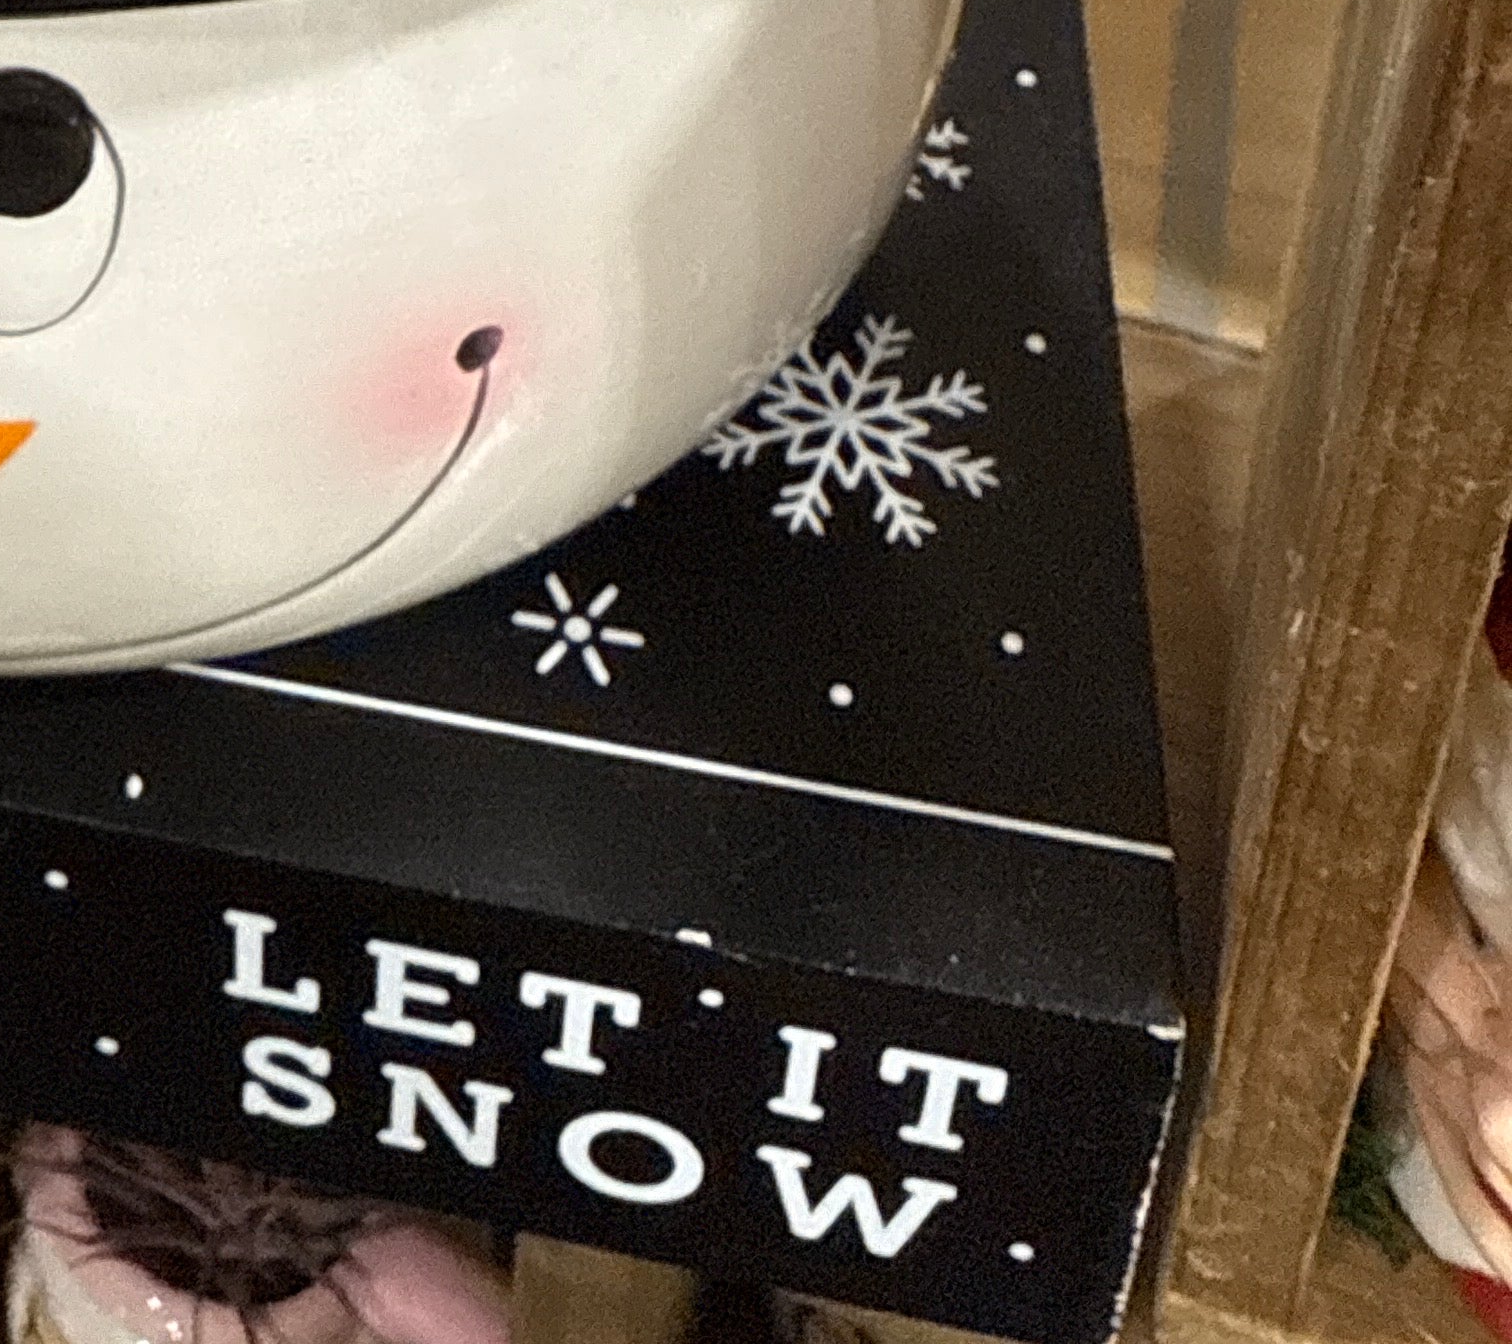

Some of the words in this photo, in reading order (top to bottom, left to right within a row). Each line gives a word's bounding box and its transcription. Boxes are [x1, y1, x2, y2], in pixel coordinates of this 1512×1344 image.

[223, 909, 642, 1075] LET
[766, 1025, 1009, 1152] IT
[242, 1036, 958, 1258] SNOW
